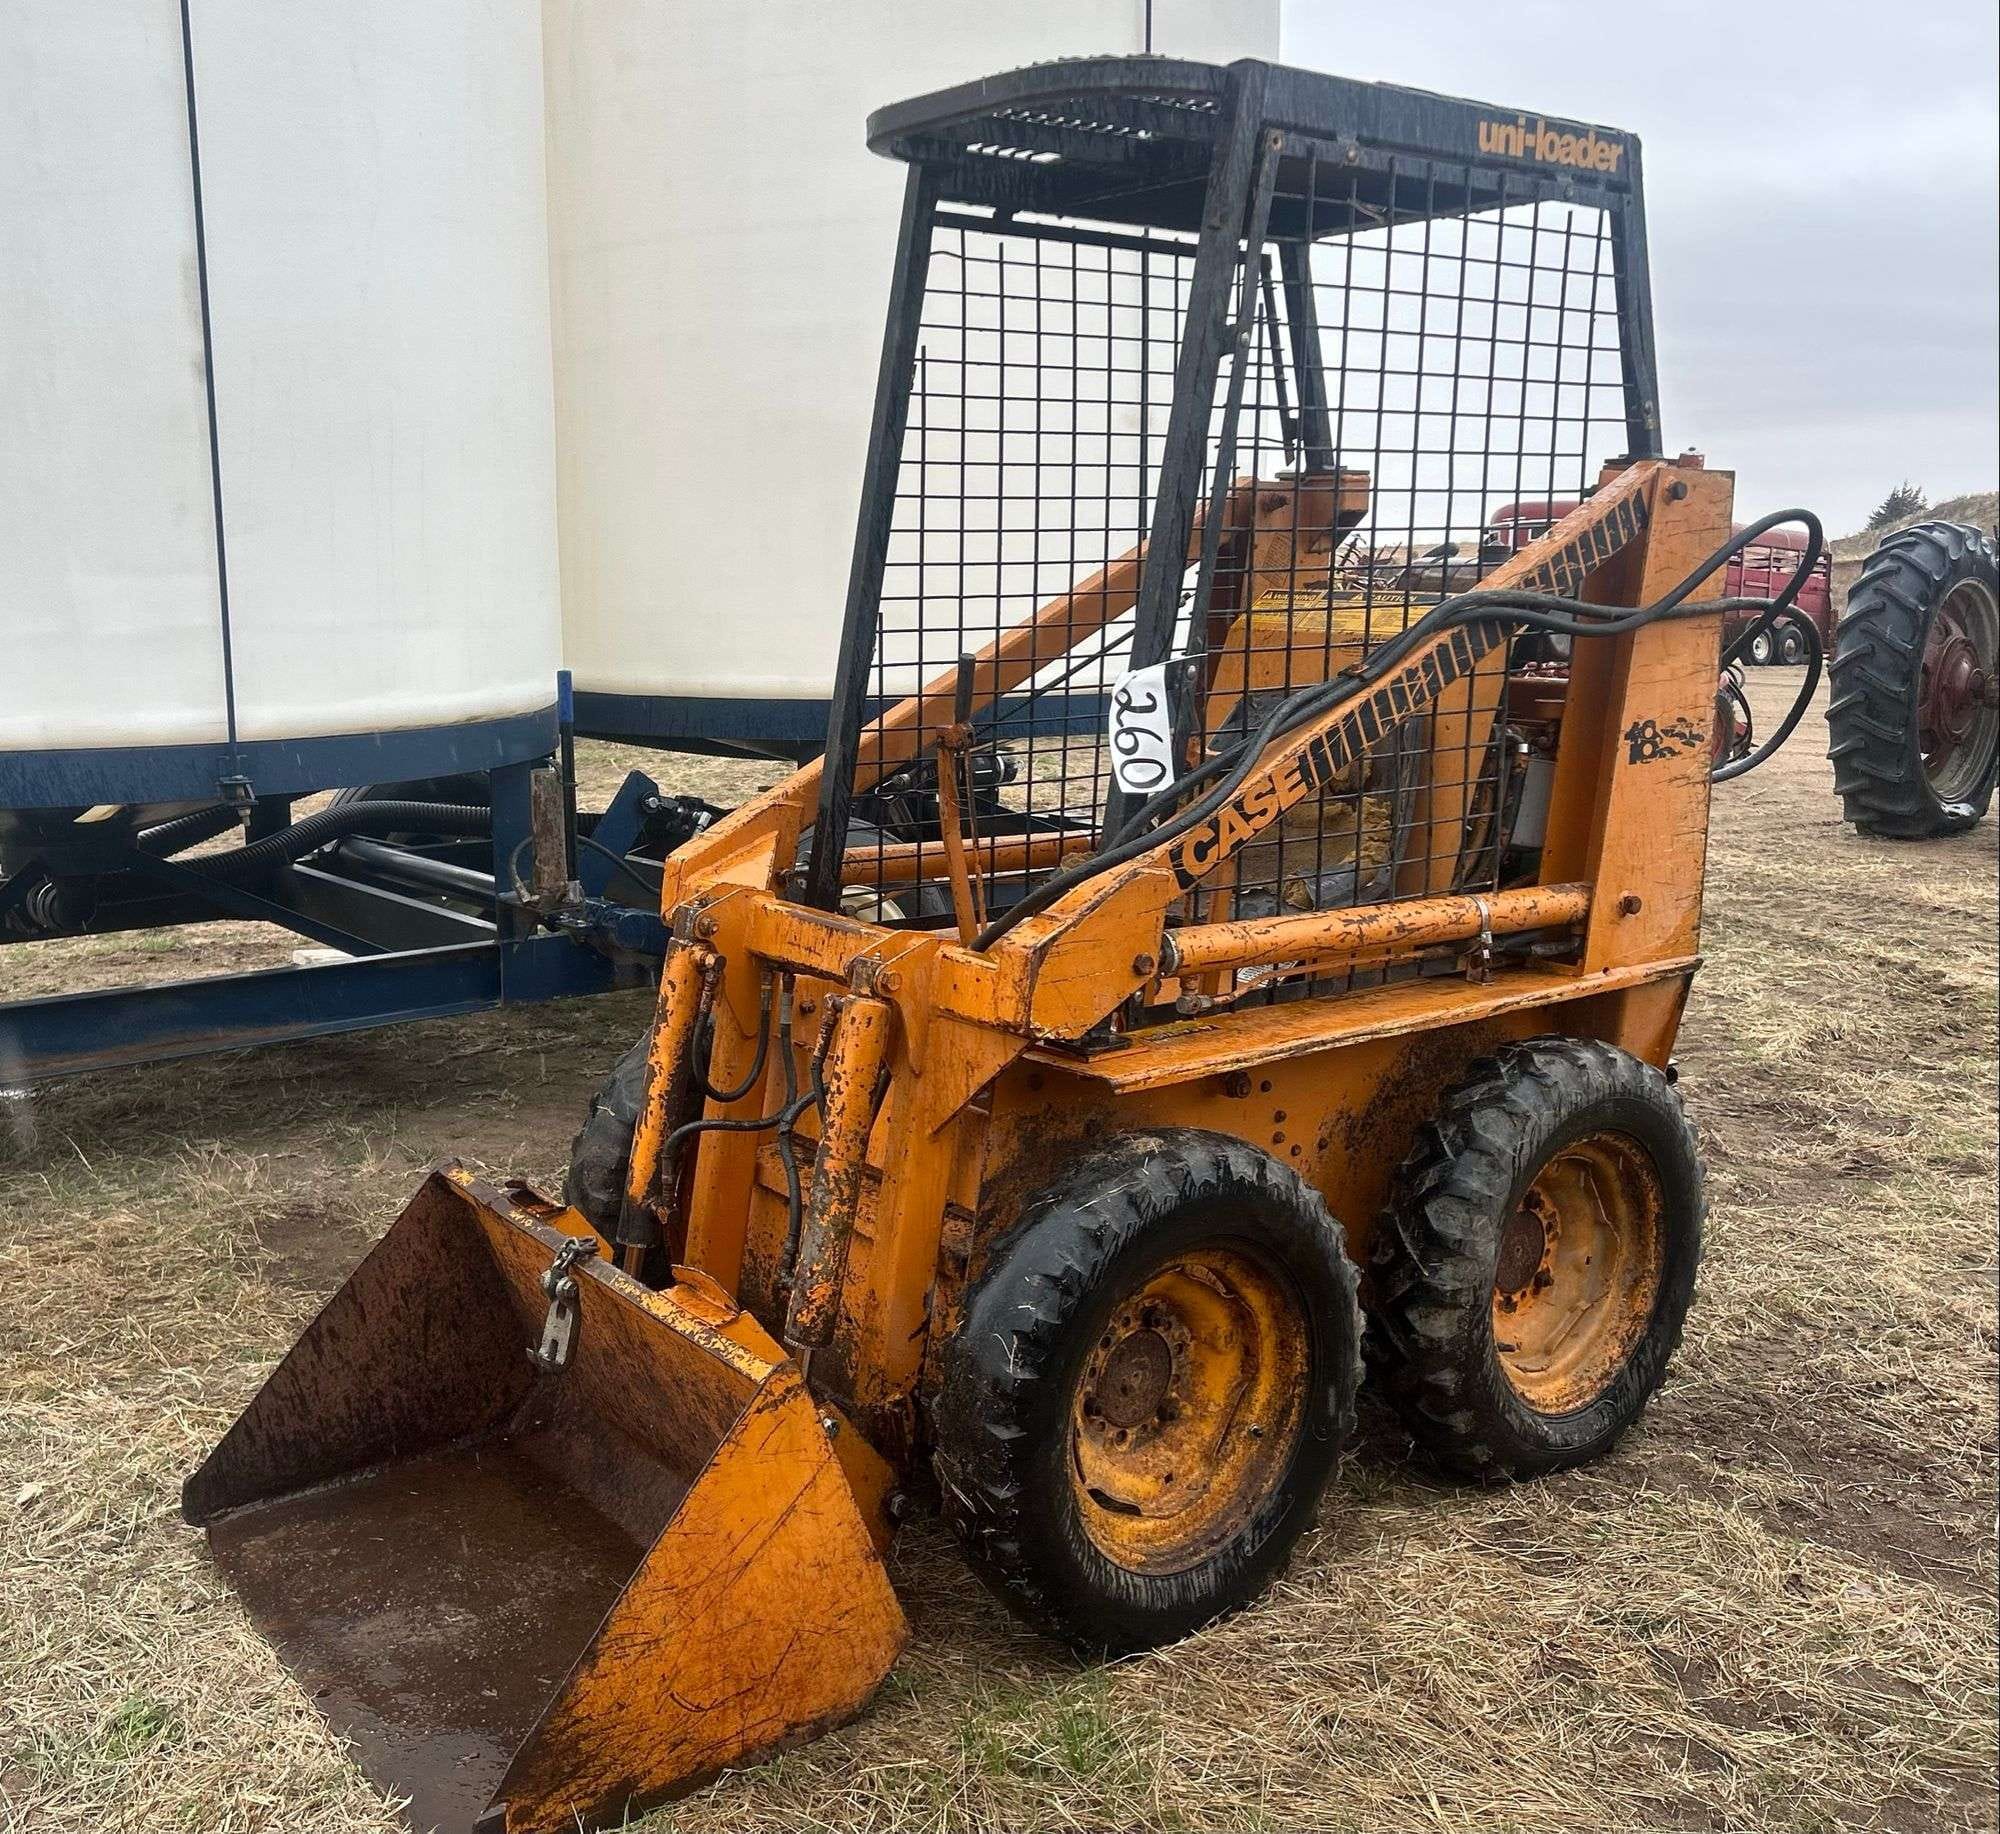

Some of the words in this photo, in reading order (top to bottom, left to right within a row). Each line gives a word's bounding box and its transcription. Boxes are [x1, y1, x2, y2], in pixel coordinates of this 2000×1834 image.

[1477, 115, 1624, 173] uni-loader
[1114, 686, 1167, 789] 260
[1182, 756, 1309, 876] CASE
